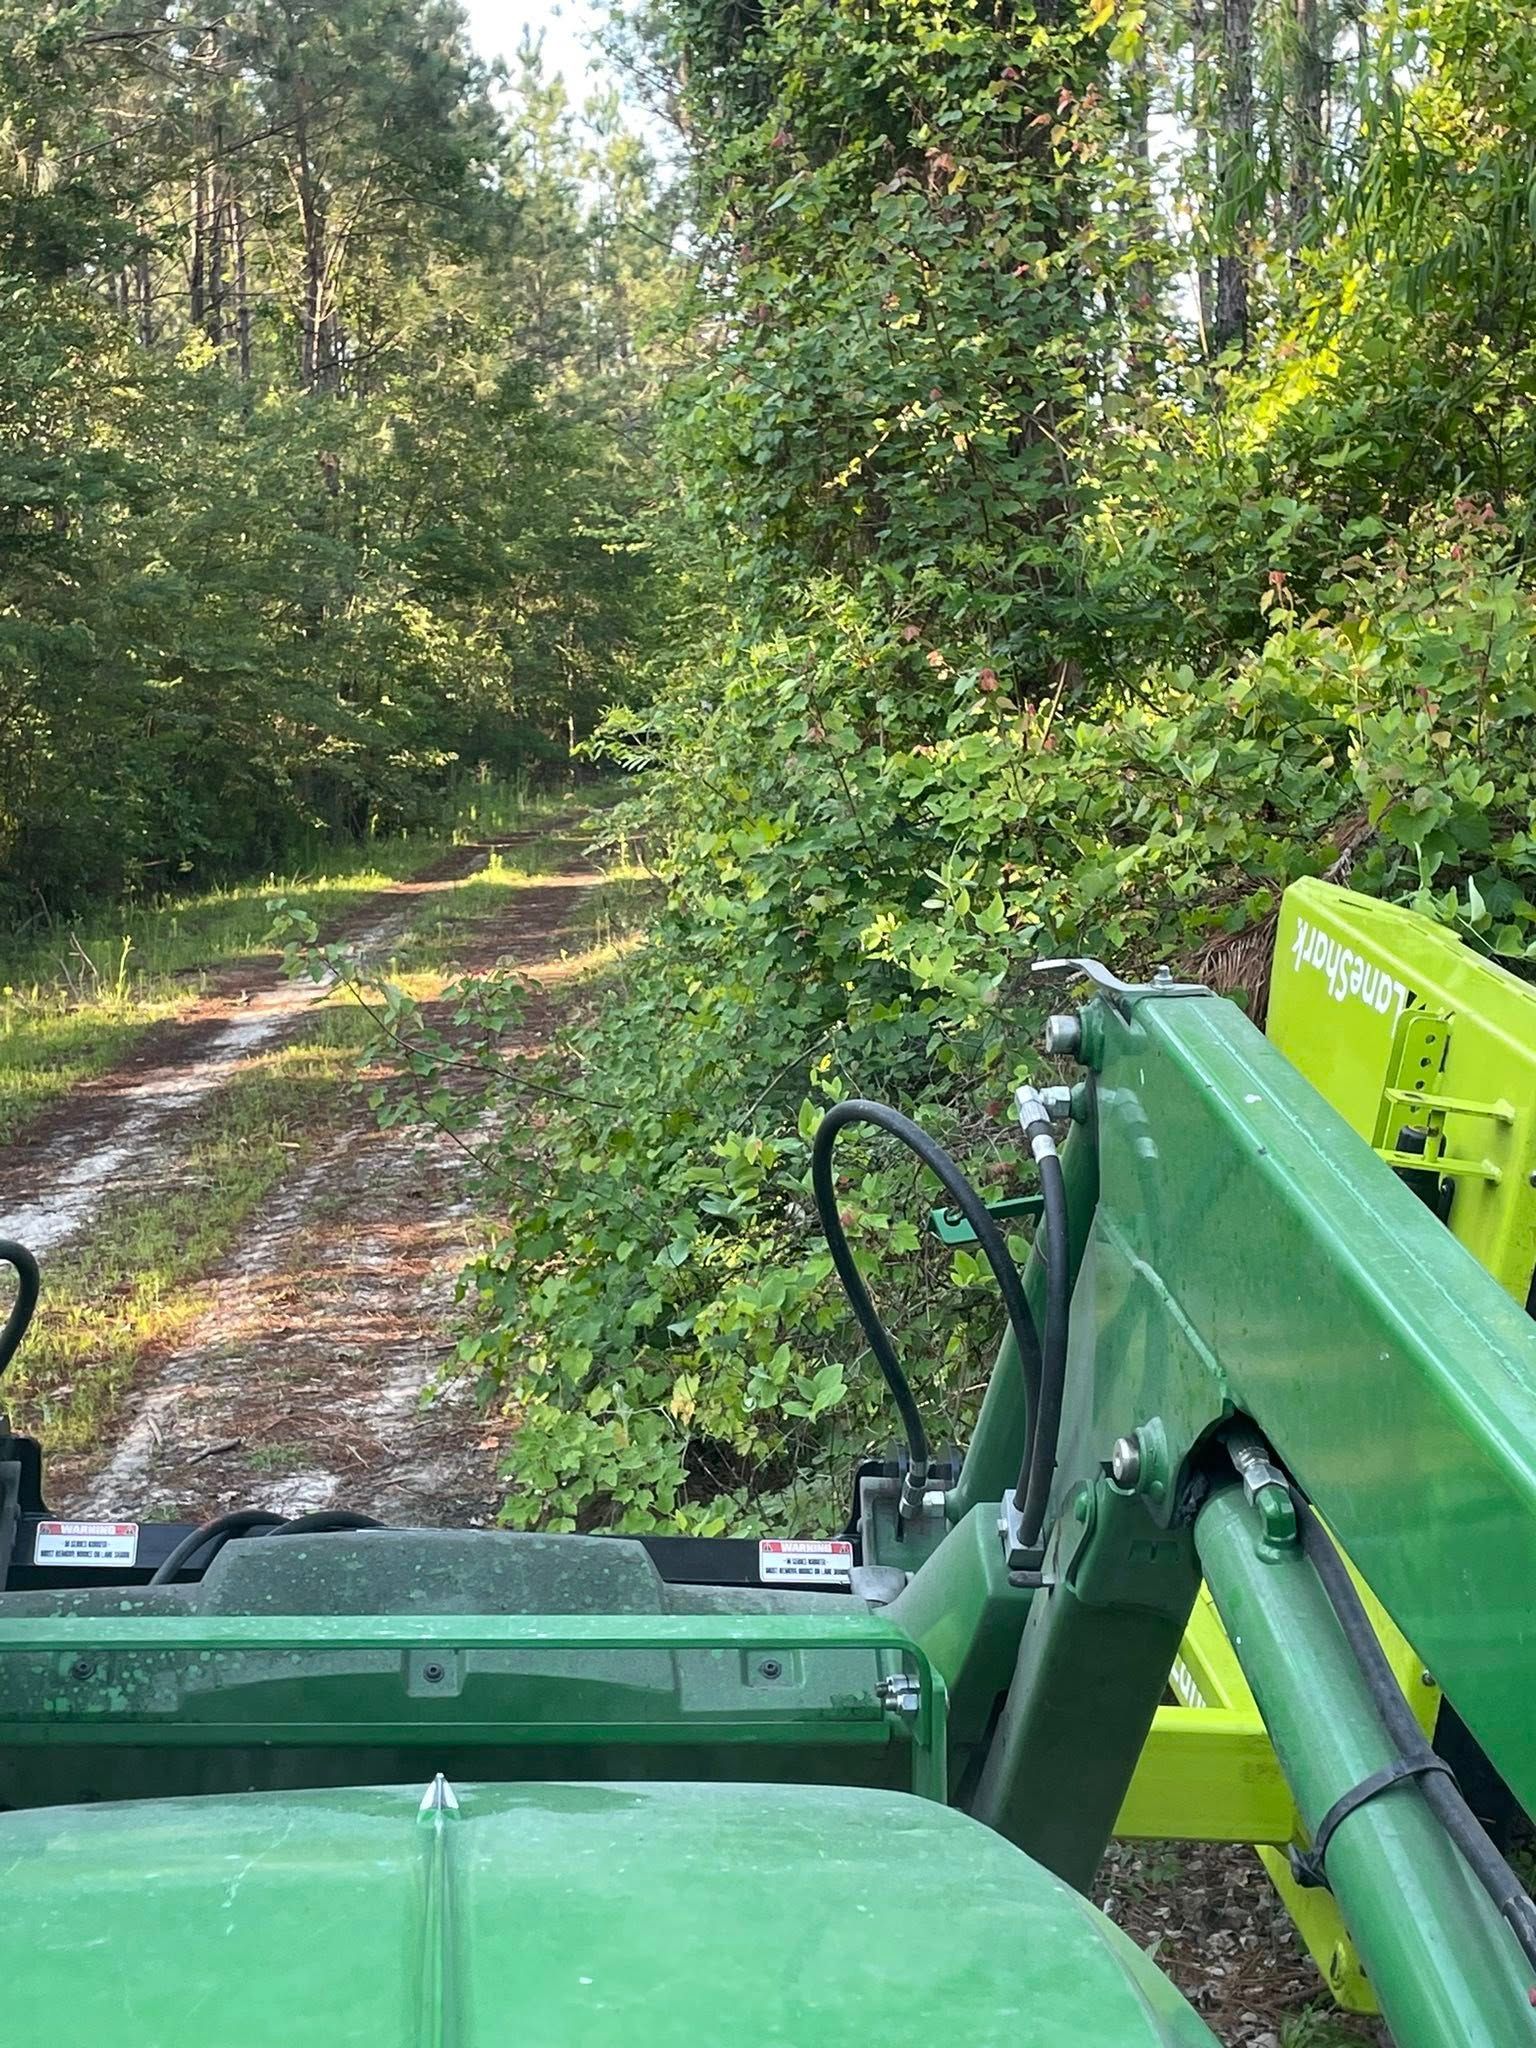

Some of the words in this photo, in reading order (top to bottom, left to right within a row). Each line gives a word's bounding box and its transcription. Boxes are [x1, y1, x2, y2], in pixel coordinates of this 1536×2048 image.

[1291, 916, 1407, 1039] LaneShark
[61, 1525, 115, 1535] WARNING
[782, 1543, 832, 1553] WARNING
